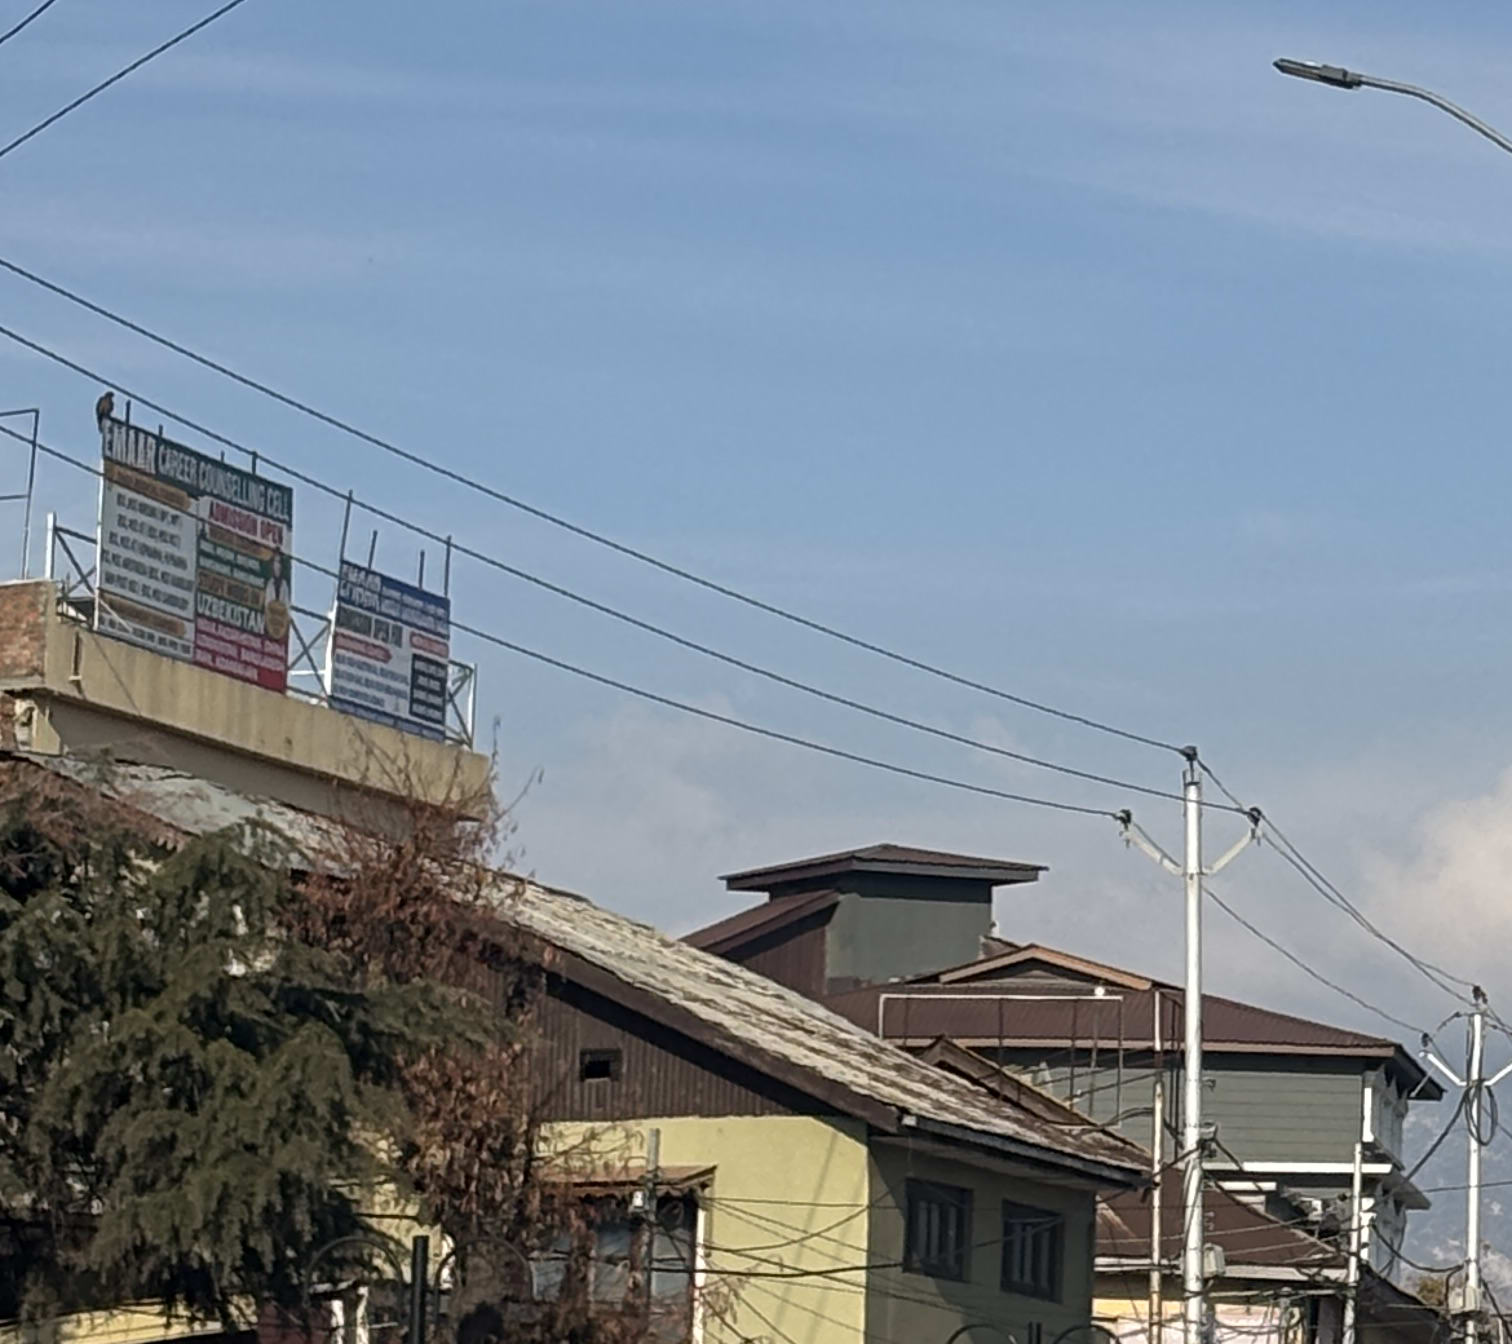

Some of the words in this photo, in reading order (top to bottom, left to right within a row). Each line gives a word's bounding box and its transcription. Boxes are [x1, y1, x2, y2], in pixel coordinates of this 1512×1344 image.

[158, 445, 198, 488] CAREER
[199, 461, 266, 513] COUNSELLING
[267, 487, 290, 522] CELL
[260, 519, 284, 546] OPEN
[197, 593, 266, 635] UZBEKISTAN
